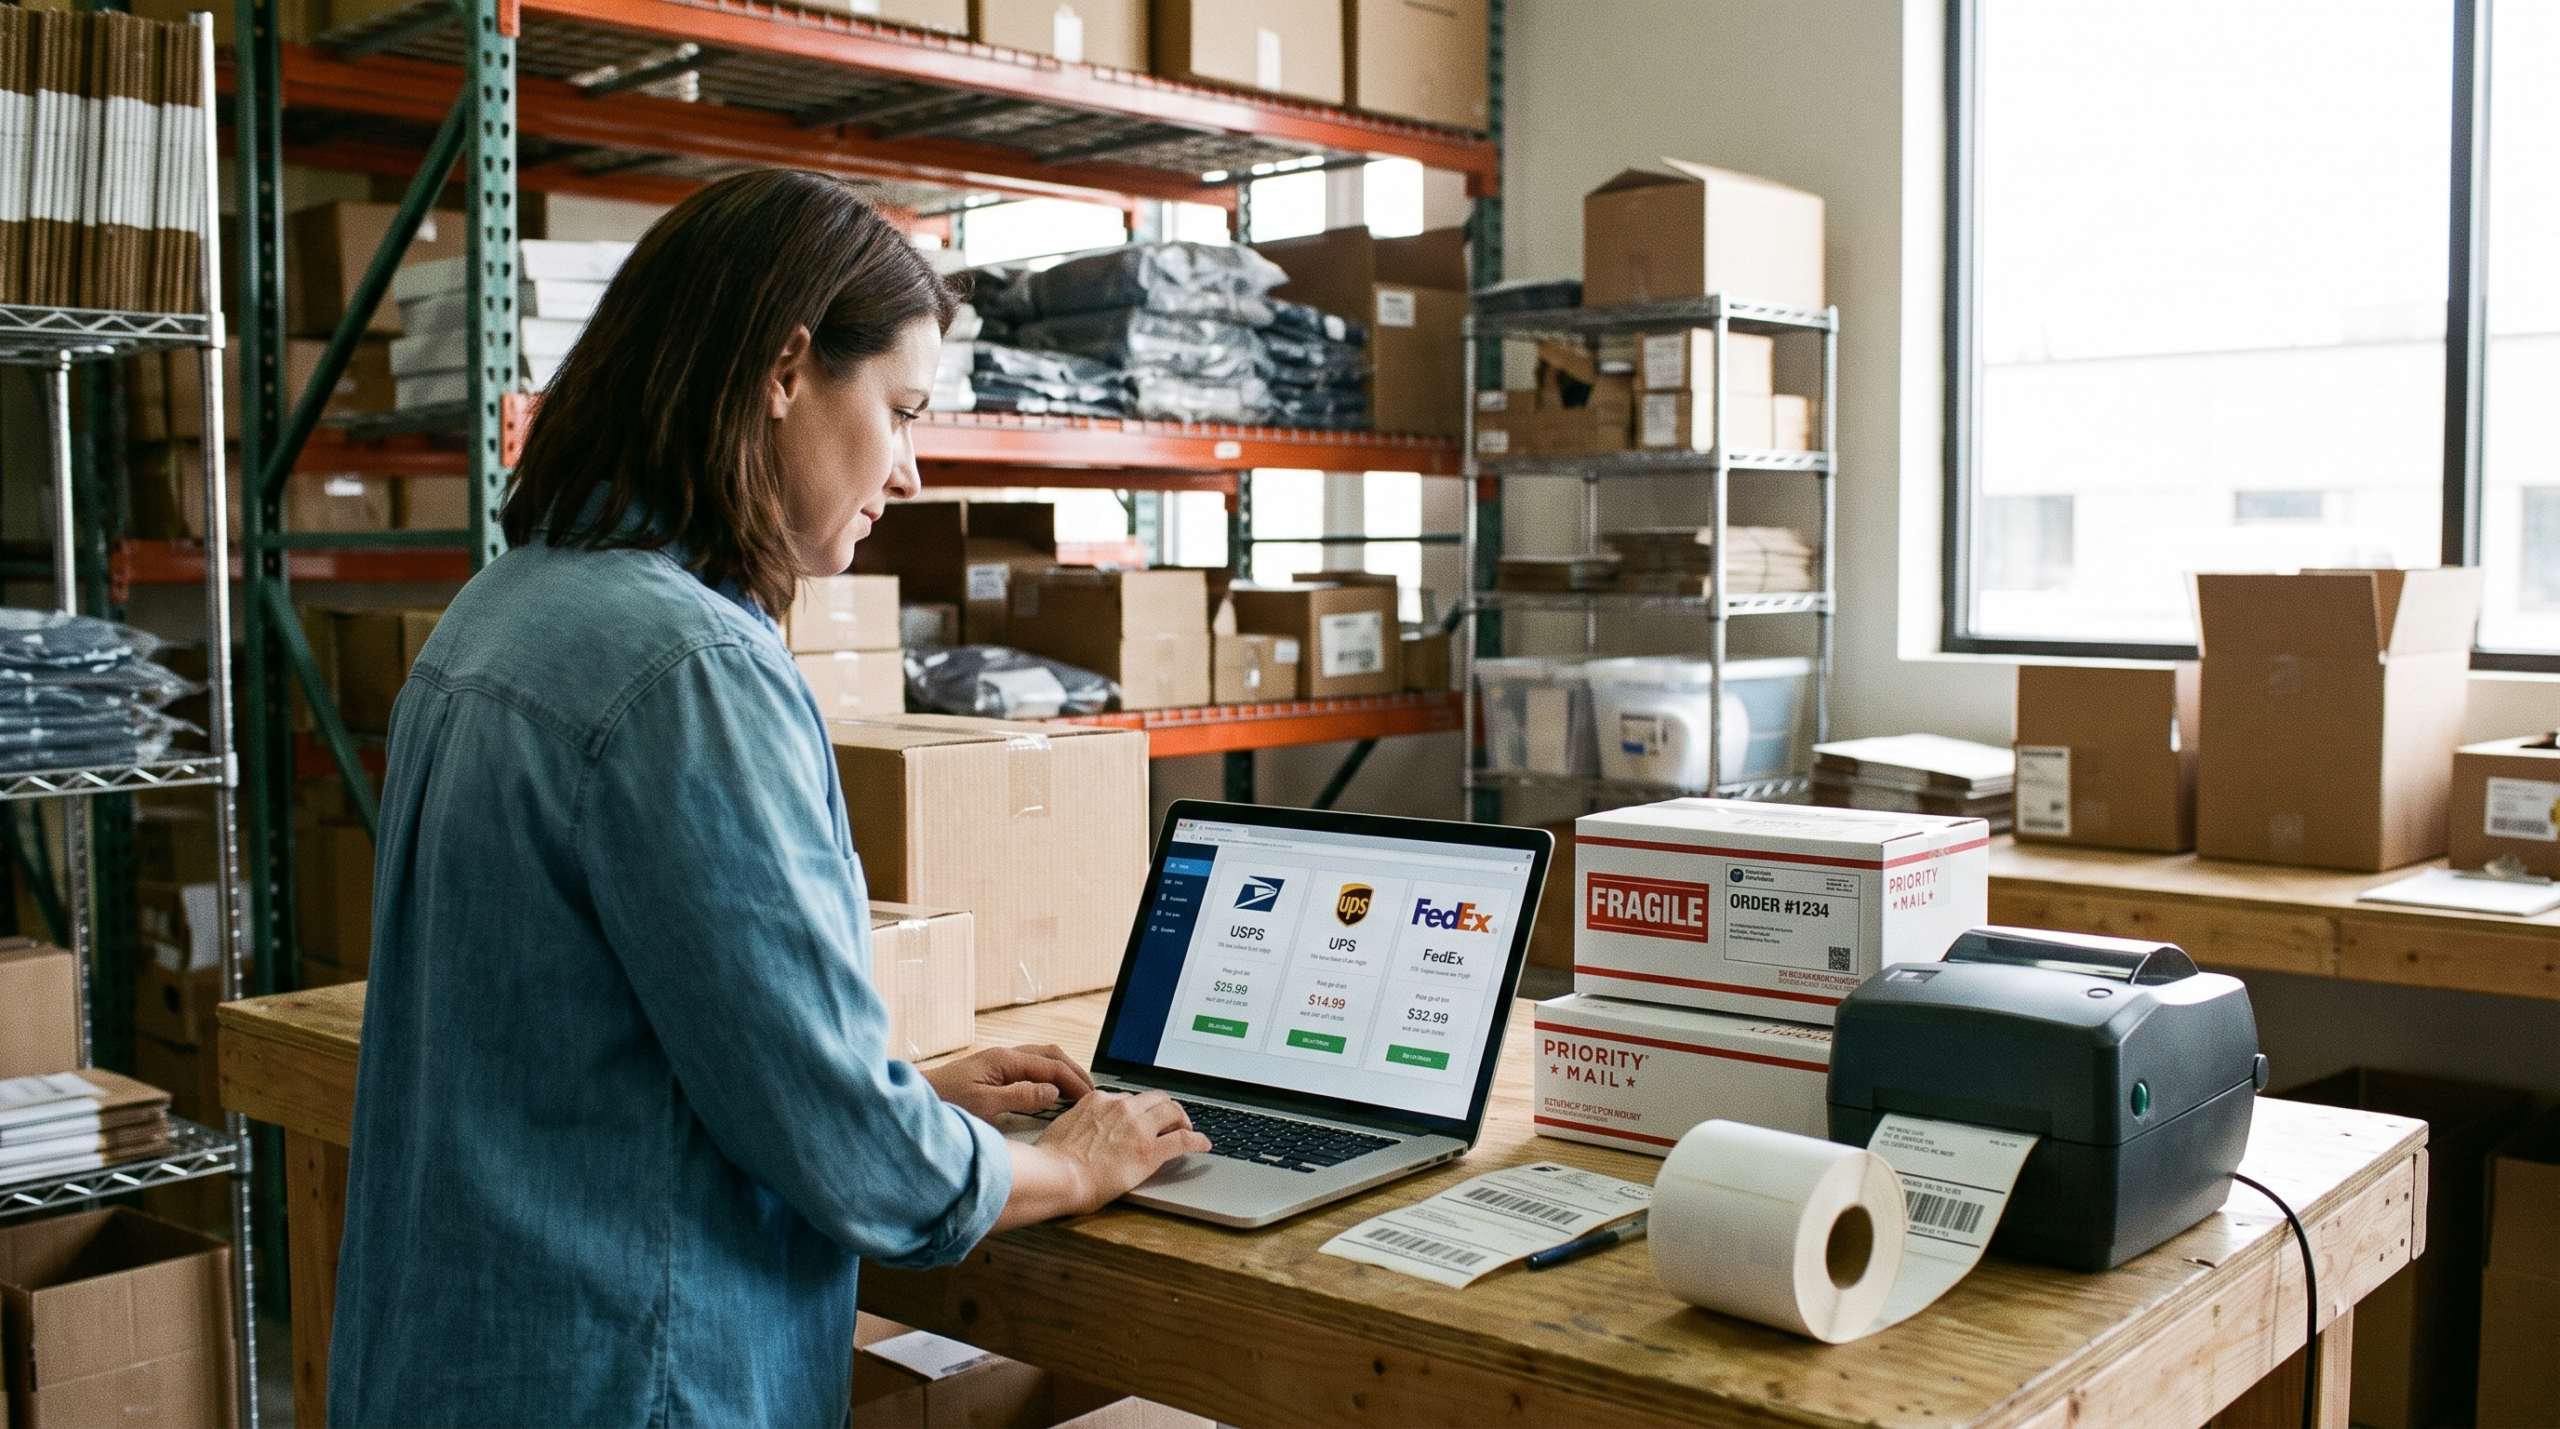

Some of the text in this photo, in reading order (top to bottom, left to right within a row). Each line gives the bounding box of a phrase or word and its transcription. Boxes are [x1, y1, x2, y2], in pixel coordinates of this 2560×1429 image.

[1889, 867, 1938, 894] PRIORITY
[1339, 895, 1369, 920] ups
[1591, 886, 1703, 927] FRAGILE
[1730, 893, 1829, 918] ORDER #1234
[1901, 891, 1927, 910] MAIL
[1411, 898, 1493, 933] FedEx
[1230, 925, 1265, 941] USPS
[1329, 937, 1357, 952] UPS
[1422, 948, 1465, 966] FedEx
[1213, 980, 1248, 995] $25.99
[1308, 994, 1346, 1010] $14.99
[1407, 1007, 1449, 1024] $32.99
[1544, 1039, 1645, 1071] PRIORITY
[1567, 1065, 1619, 1088] MAIL
